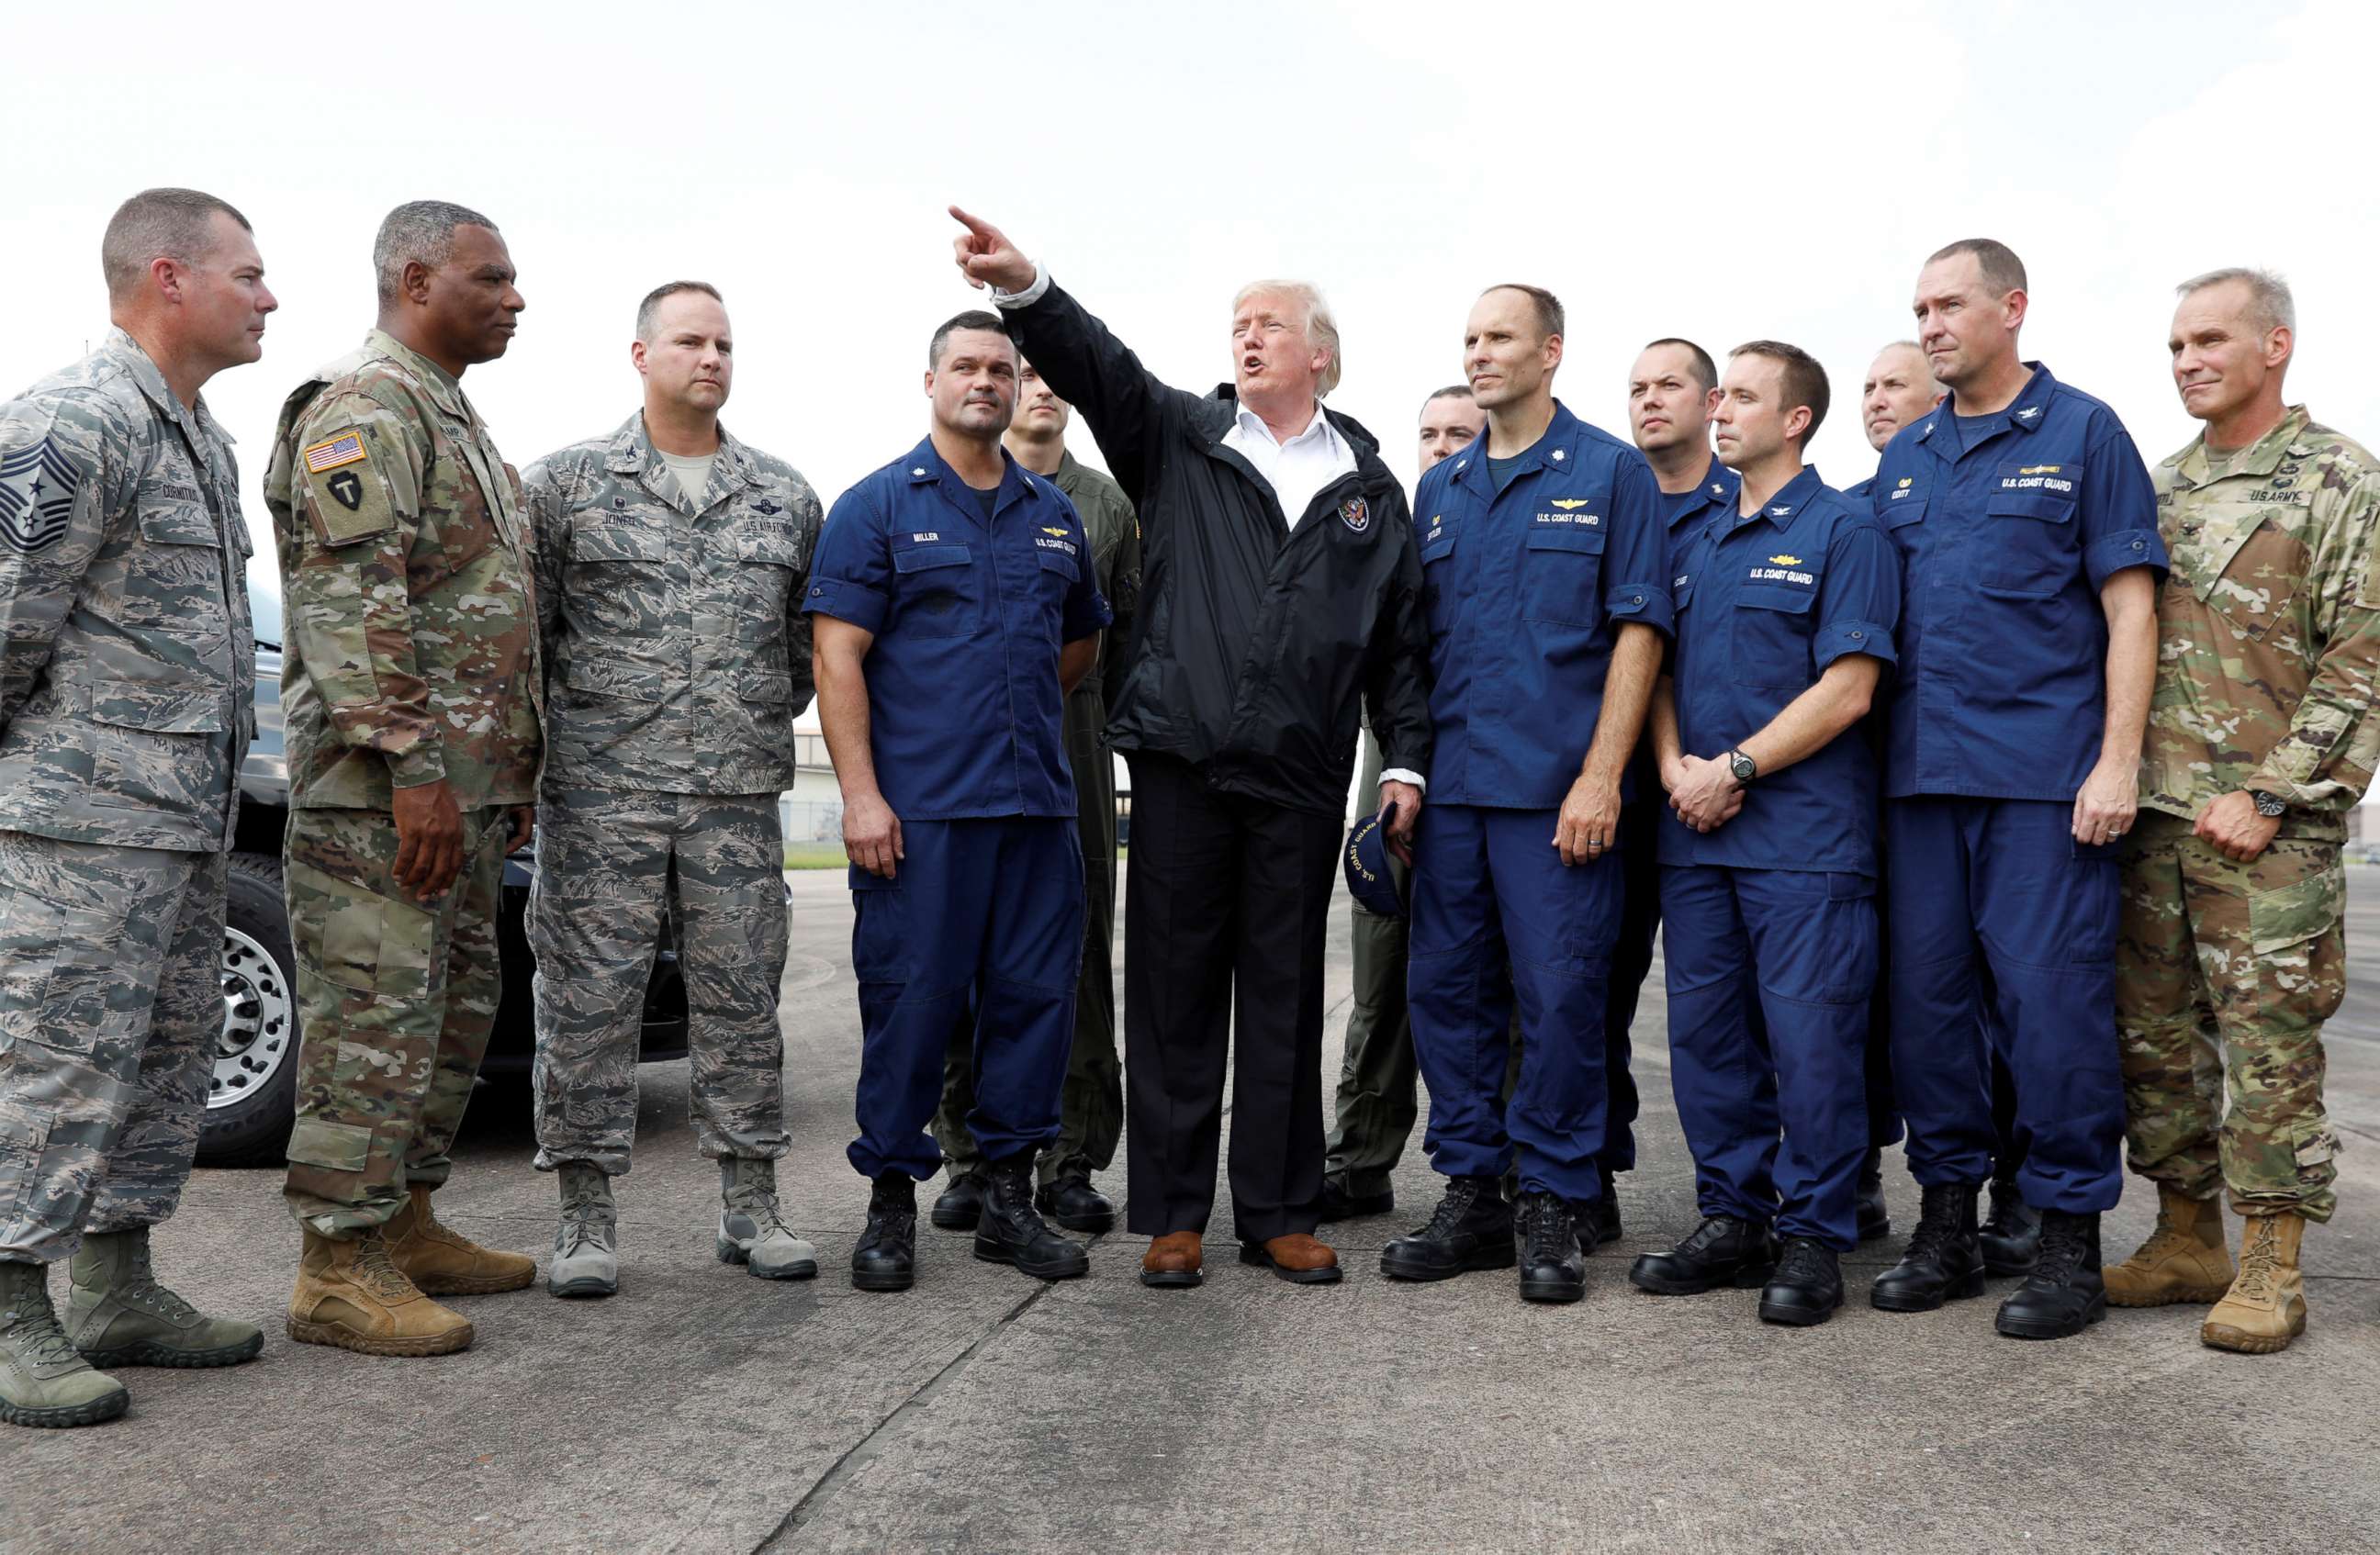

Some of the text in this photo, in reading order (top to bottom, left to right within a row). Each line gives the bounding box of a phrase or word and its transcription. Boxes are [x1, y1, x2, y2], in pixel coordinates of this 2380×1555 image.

[2002, 477, 2071, 492] U.S. COAST GUARD
[602, 513, 634, 526] JONES
[1536, 513, 1599, 525] U.S. COAST GUARD
[759, 521, 771, 532] AIR
[913, 532, 939, 543] MILLER
[1047, 539, 1063, 550] COAST
[1750, 568, 1813, 585] U.S. COAST GUARD
[1350, 845, 1363, 871] COAST
